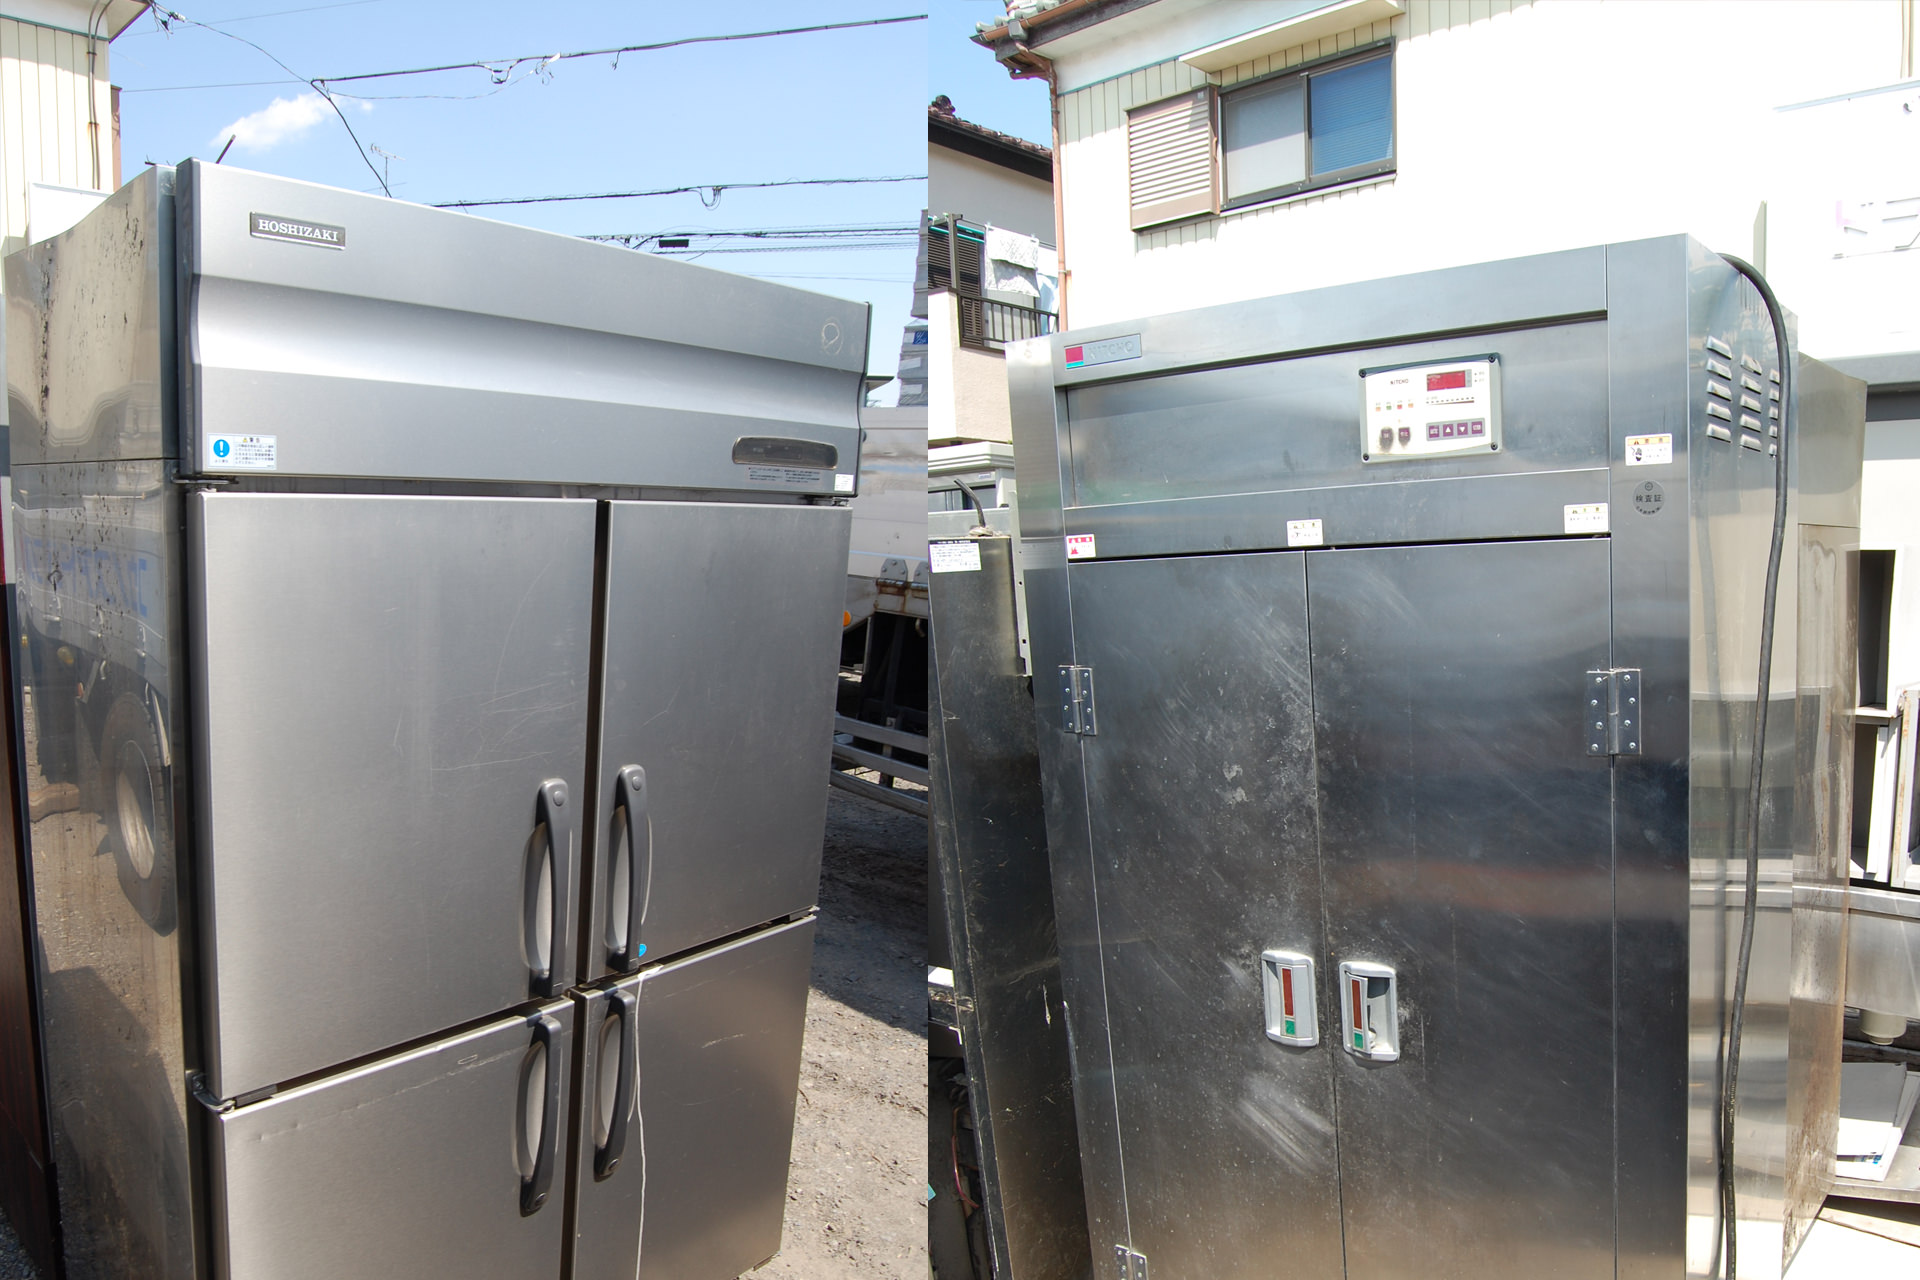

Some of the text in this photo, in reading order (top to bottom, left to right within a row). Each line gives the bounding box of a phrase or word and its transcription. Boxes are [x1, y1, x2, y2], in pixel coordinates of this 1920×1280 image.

[258, 219, 338, 241] HOSHIZAKI
[1636, 494, 1662, 503] 検査証
